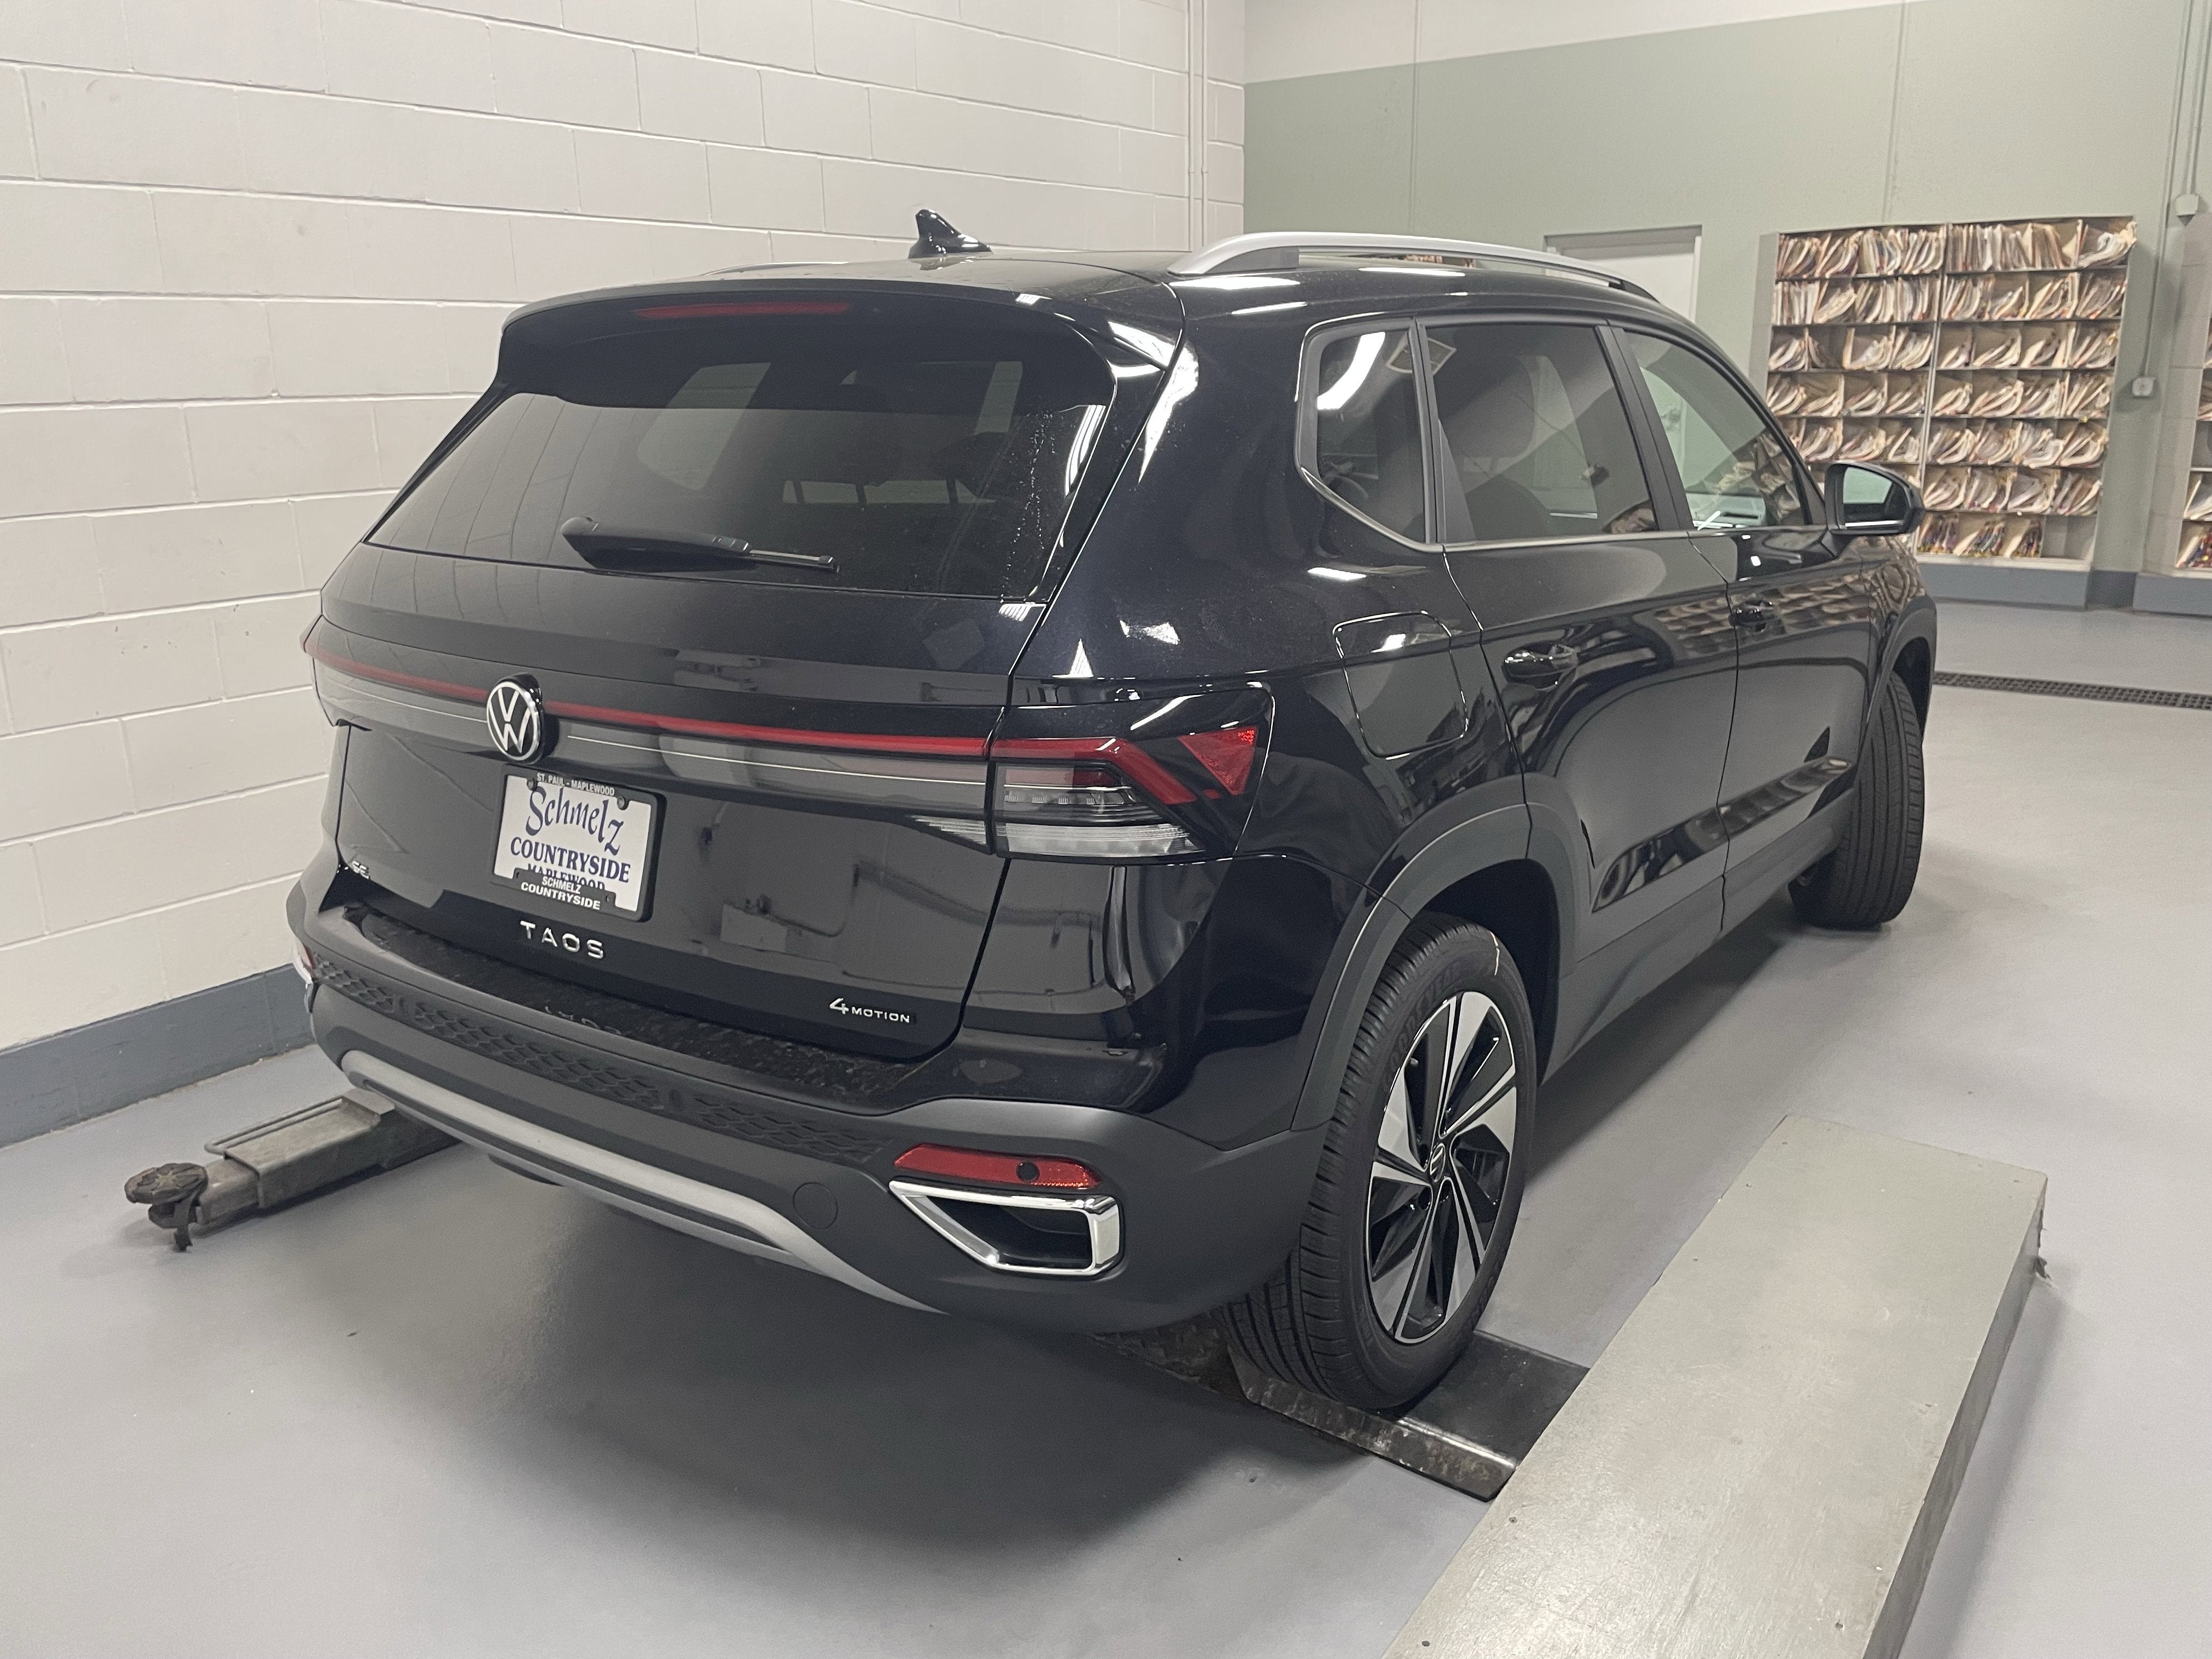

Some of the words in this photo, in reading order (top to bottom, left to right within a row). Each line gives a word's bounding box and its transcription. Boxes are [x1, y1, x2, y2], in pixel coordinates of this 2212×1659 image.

[537, 772, 547, 782] ST.
[549, 775, 565, 787] PAUL
[571, 780, 614, 796] MAPLEWOOD
[526, 786, 624, 856] Schmelz
[511, 837, 631, 883] COUNTRYSIDE
[521, 882, 601, 910] COUNTRYSIDE
[542, 876, 582, 894] SCHMELZ
[520, 921, 603, 959] TAOS
